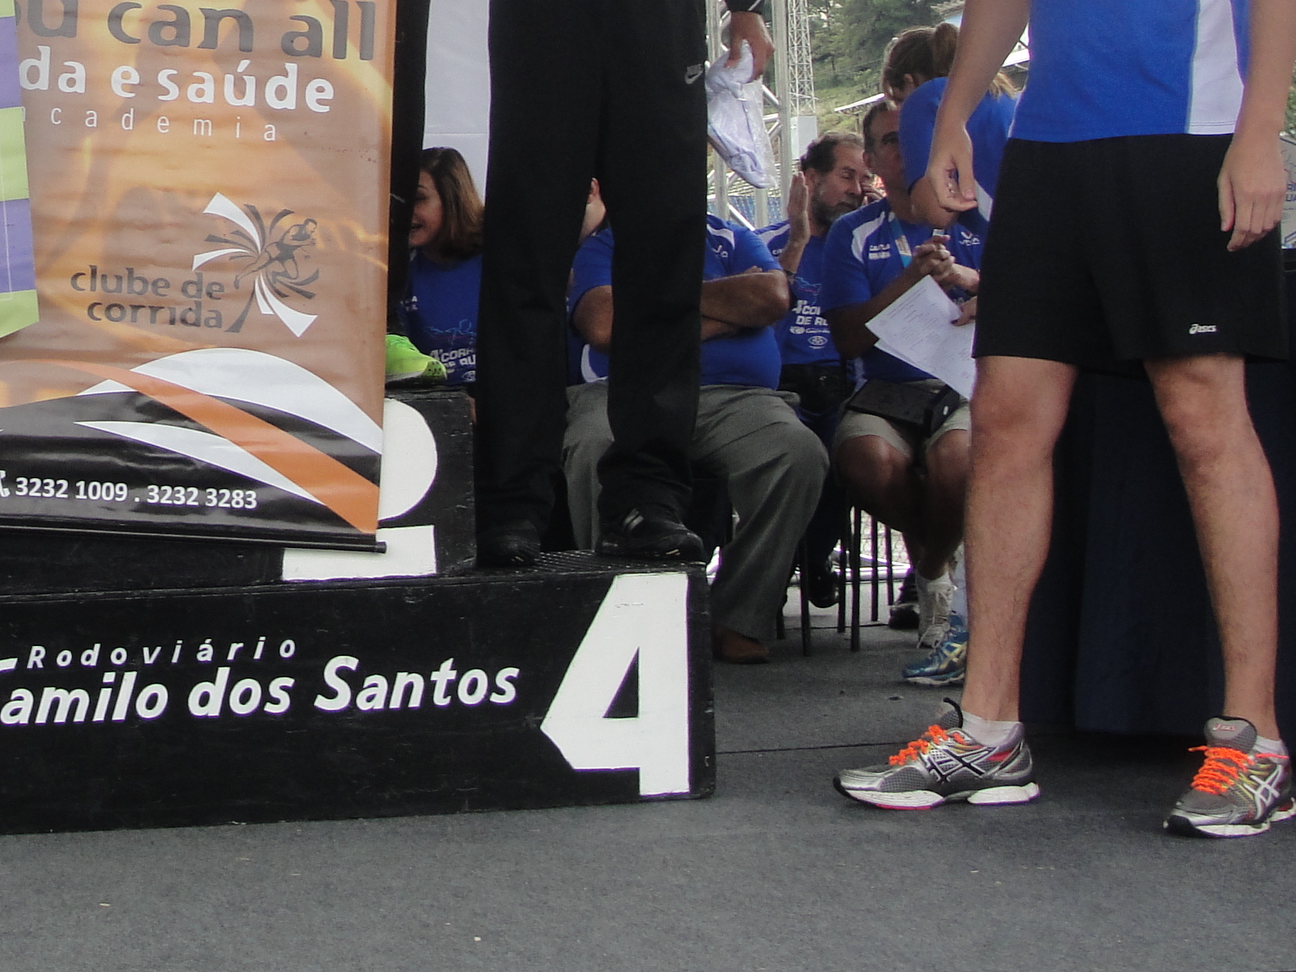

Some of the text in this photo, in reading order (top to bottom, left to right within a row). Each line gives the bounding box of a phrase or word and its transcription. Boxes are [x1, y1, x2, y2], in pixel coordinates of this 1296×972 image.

[107, 1, 254, 53] can
[280, 0, 376, 61] all
[19, 45, 335, 113] da e saúde
[70, 265, 225, 301] clube de
[87, 297, 223, 330] corrida
[15, 477, 258, 509] 3232 1009 3232 3283
[27, 637, 296, 669] Rodoviário
[188, 667, 294, 718] dos
[314, 656, 519, 712] Santos
[540, 571, 690, 796] 4
